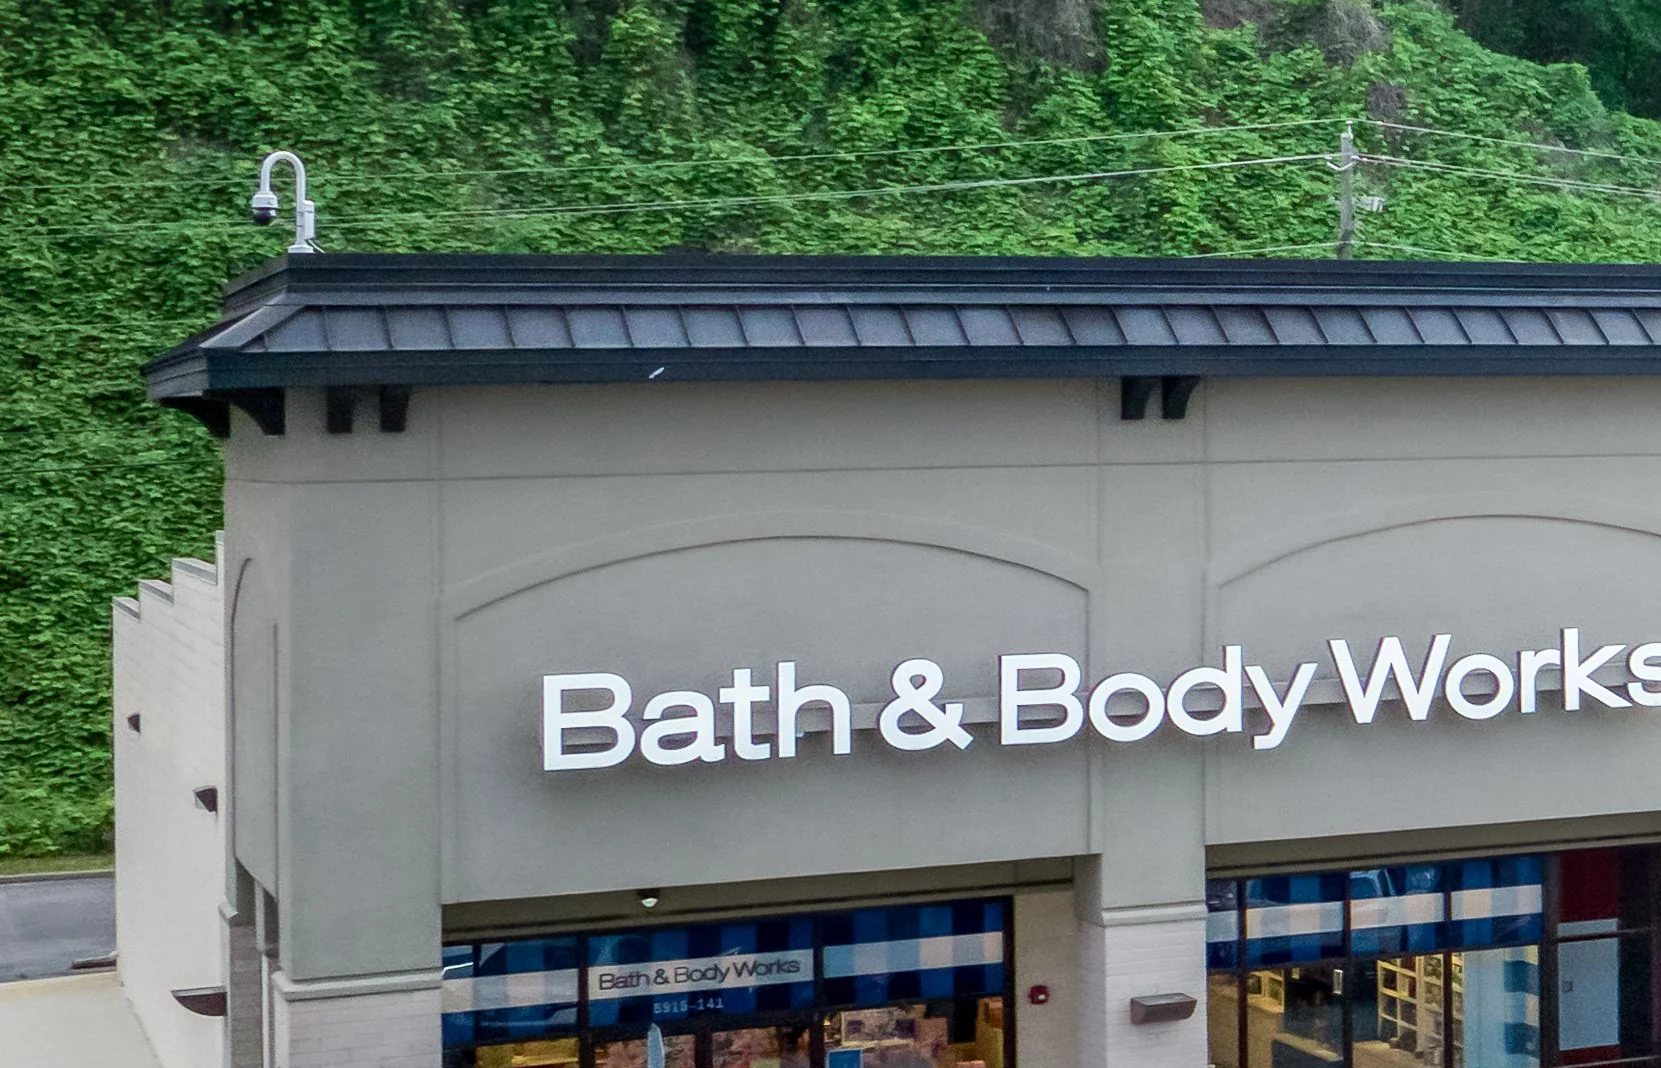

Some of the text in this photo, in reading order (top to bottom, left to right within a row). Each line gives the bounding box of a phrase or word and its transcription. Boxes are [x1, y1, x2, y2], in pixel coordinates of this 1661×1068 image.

[542, 661, 851, 772] Bath
[880, 658, 972, 751] &
[1000, 645, 1318, 748] Body
[599, 958, 801, 991] Bath & Body Works
